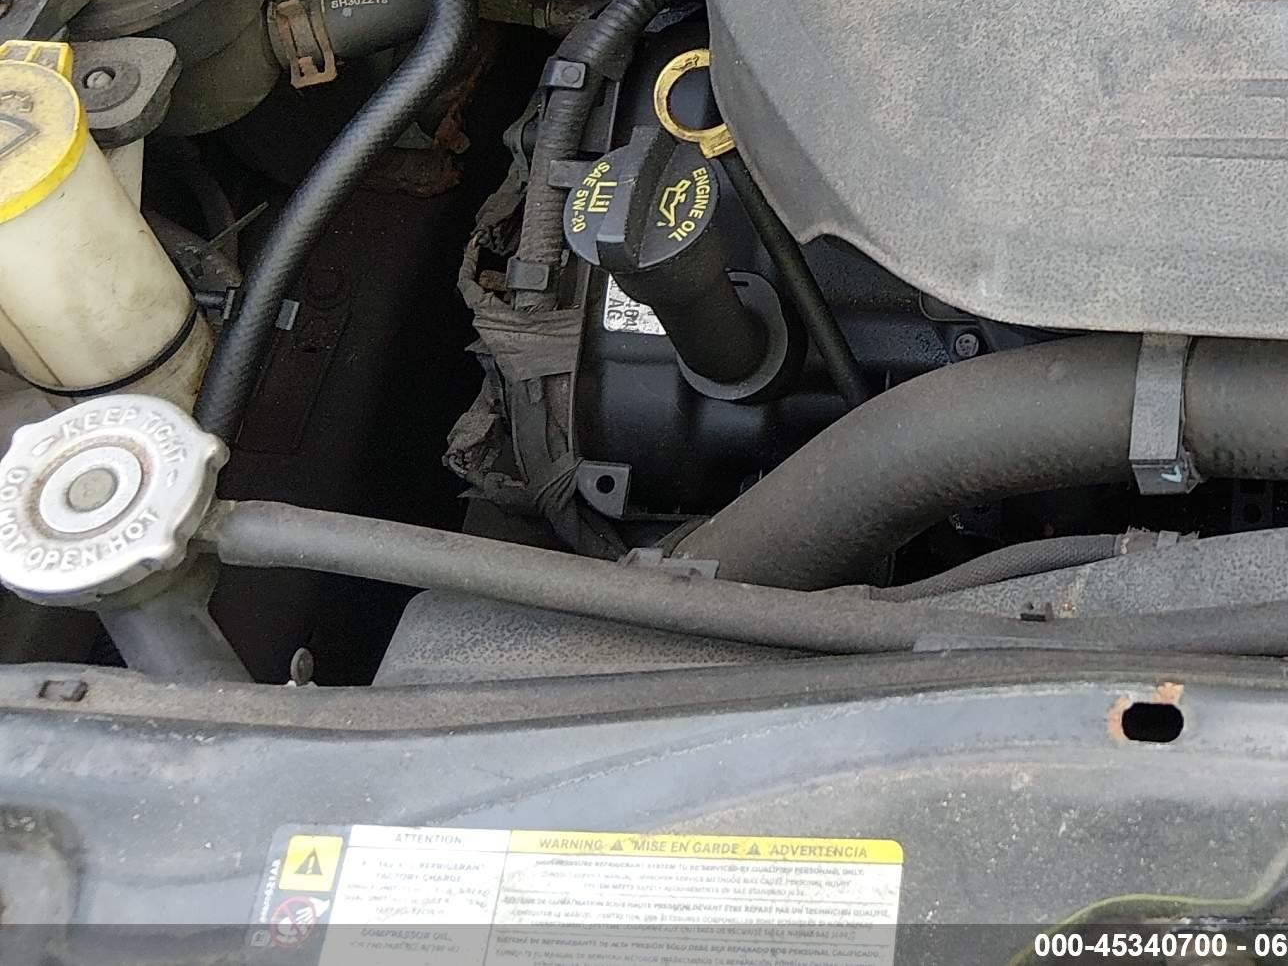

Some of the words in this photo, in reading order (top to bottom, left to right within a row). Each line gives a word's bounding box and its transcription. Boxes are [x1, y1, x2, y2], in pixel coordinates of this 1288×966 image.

[583, 161, 610, 188] SAE
[689, 166, 712, 219] ENGINE
[572, 189, 589, 233] 5W-20
[668, 220, 697, 242] OIL
[62, 407, 138, 440] KEEP
[142, 413, 187, 464] TIGHT
[0, 466, 29, 502] DO
[0, 508, 28, 554] NOT
[108, 508, 159, 555] HOT
[25, 545, 99, 573] OPEN
[394, 834, 463, 845] ATTENTION
[539, 838, 604, 851] WARNING
[632, 840, 667, 852] MISE
[670, 842, 690, 853] EN
[692, 842, 740, 854] GARDE
[769, 843, 868, 858] ADVERTENCIA
